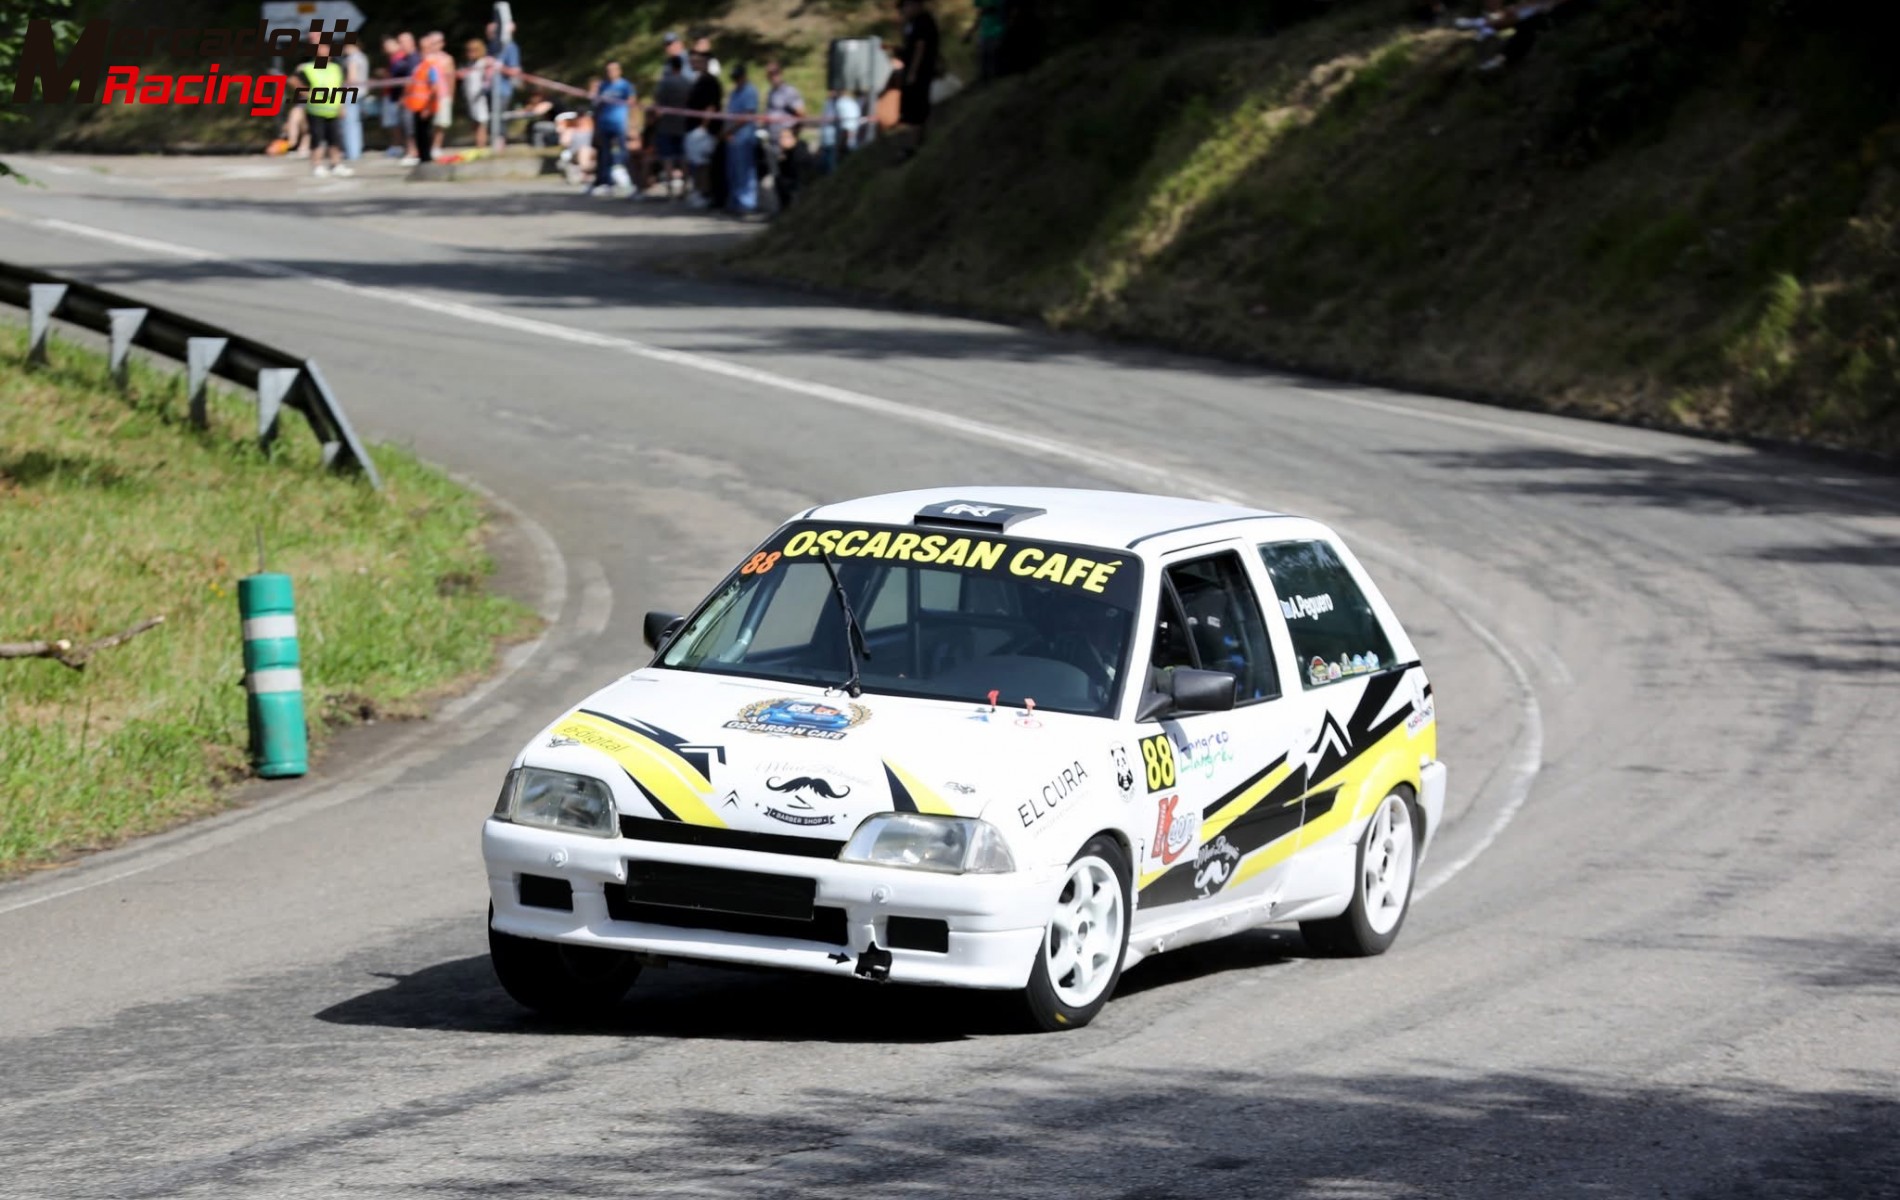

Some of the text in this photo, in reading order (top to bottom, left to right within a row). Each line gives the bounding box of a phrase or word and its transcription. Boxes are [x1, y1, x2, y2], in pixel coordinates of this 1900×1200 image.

[740, 551, 783, 575] 88
[783, 529, 1124, 594] OSCARSAN CAFÉ
[728, 721, 806, 735] OSCARSAN
[1173, 730, 1230, 756] Langreo
[1141, 735, 1175, 790] 88
[1017, 799, 1045, 828] EL
[1042, 760, 1089, 808] CURA
[775, 812, 823, 825] BARBER SHOP
